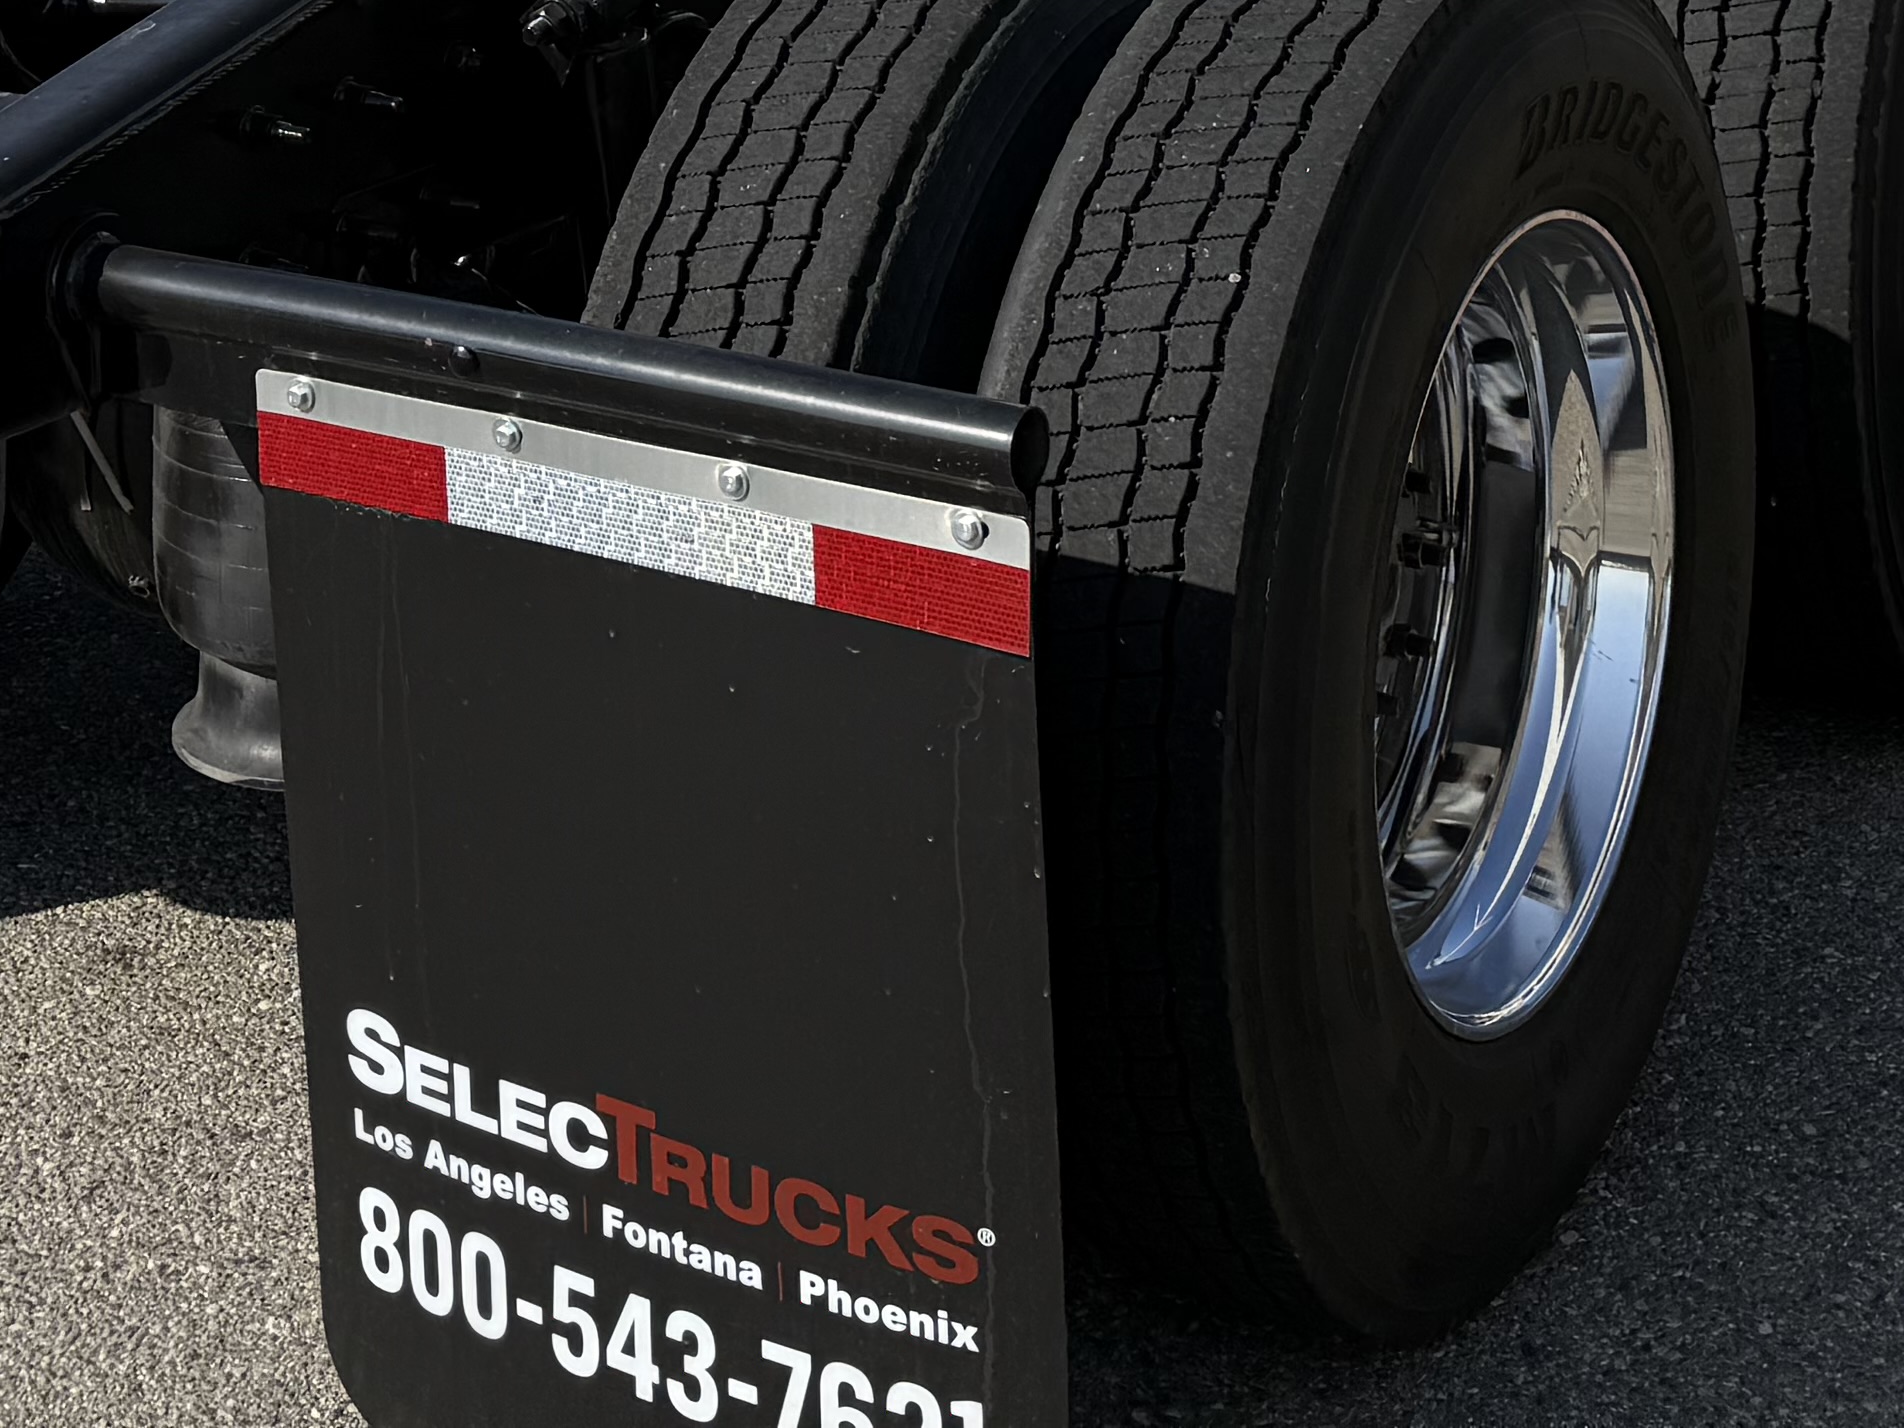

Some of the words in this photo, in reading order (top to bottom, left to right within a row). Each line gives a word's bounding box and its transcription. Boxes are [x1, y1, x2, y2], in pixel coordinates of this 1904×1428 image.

[1514, 76, 1738, 352] BRIDGESTONE
[353, 1107, 414, 1160] Los
[423, 1138, 570, 1221] Angeles
[602, 1203, 764, 1291] Fontana
[799, 1269, 980, 1353] Phoenix
[358, 1186, 984, 1428] 800-543-76
